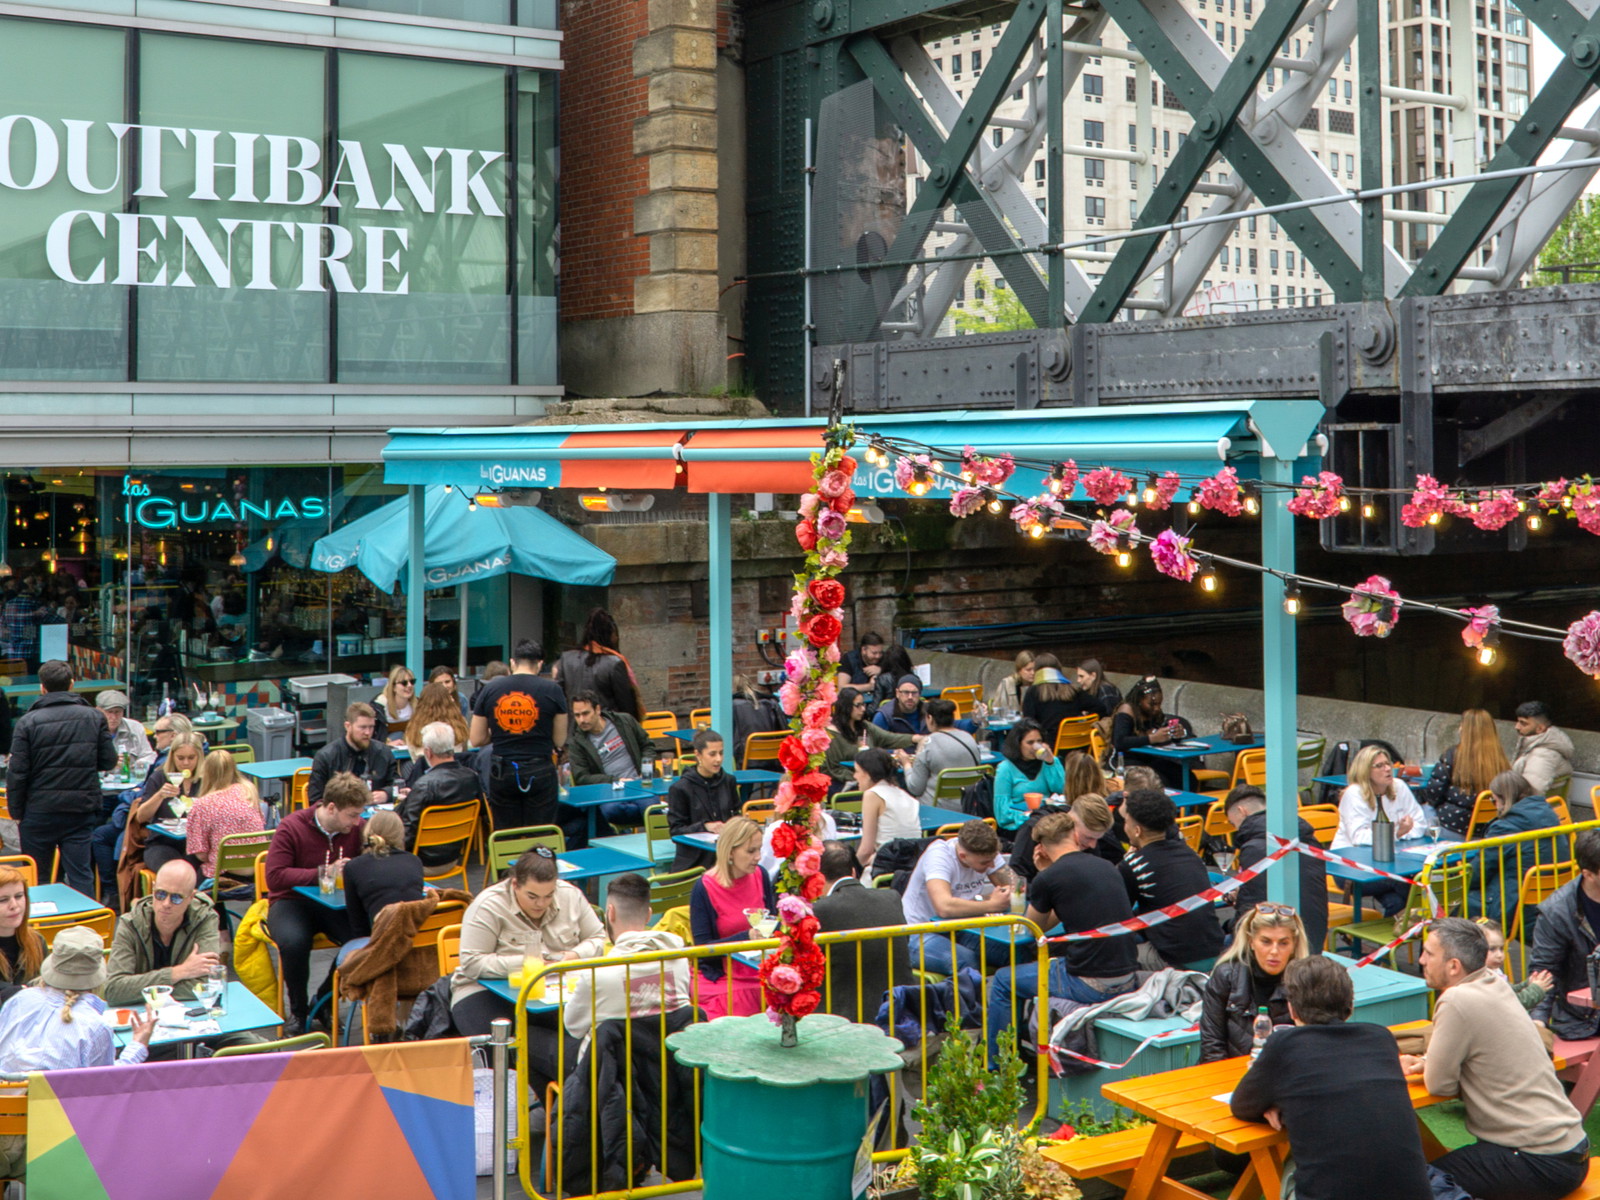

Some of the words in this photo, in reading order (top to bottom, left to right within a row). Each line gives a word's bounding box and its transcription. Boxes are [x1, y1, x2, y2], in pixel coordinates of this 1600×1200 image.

[46, 209, 410, 296] CENTRE
[489, 465, 547, 484] IGUANAS
[123, 475, 151, 496] las
[125, 497, 325, 529] IGUANAS
[500, 708, 532, 716] NACHO
